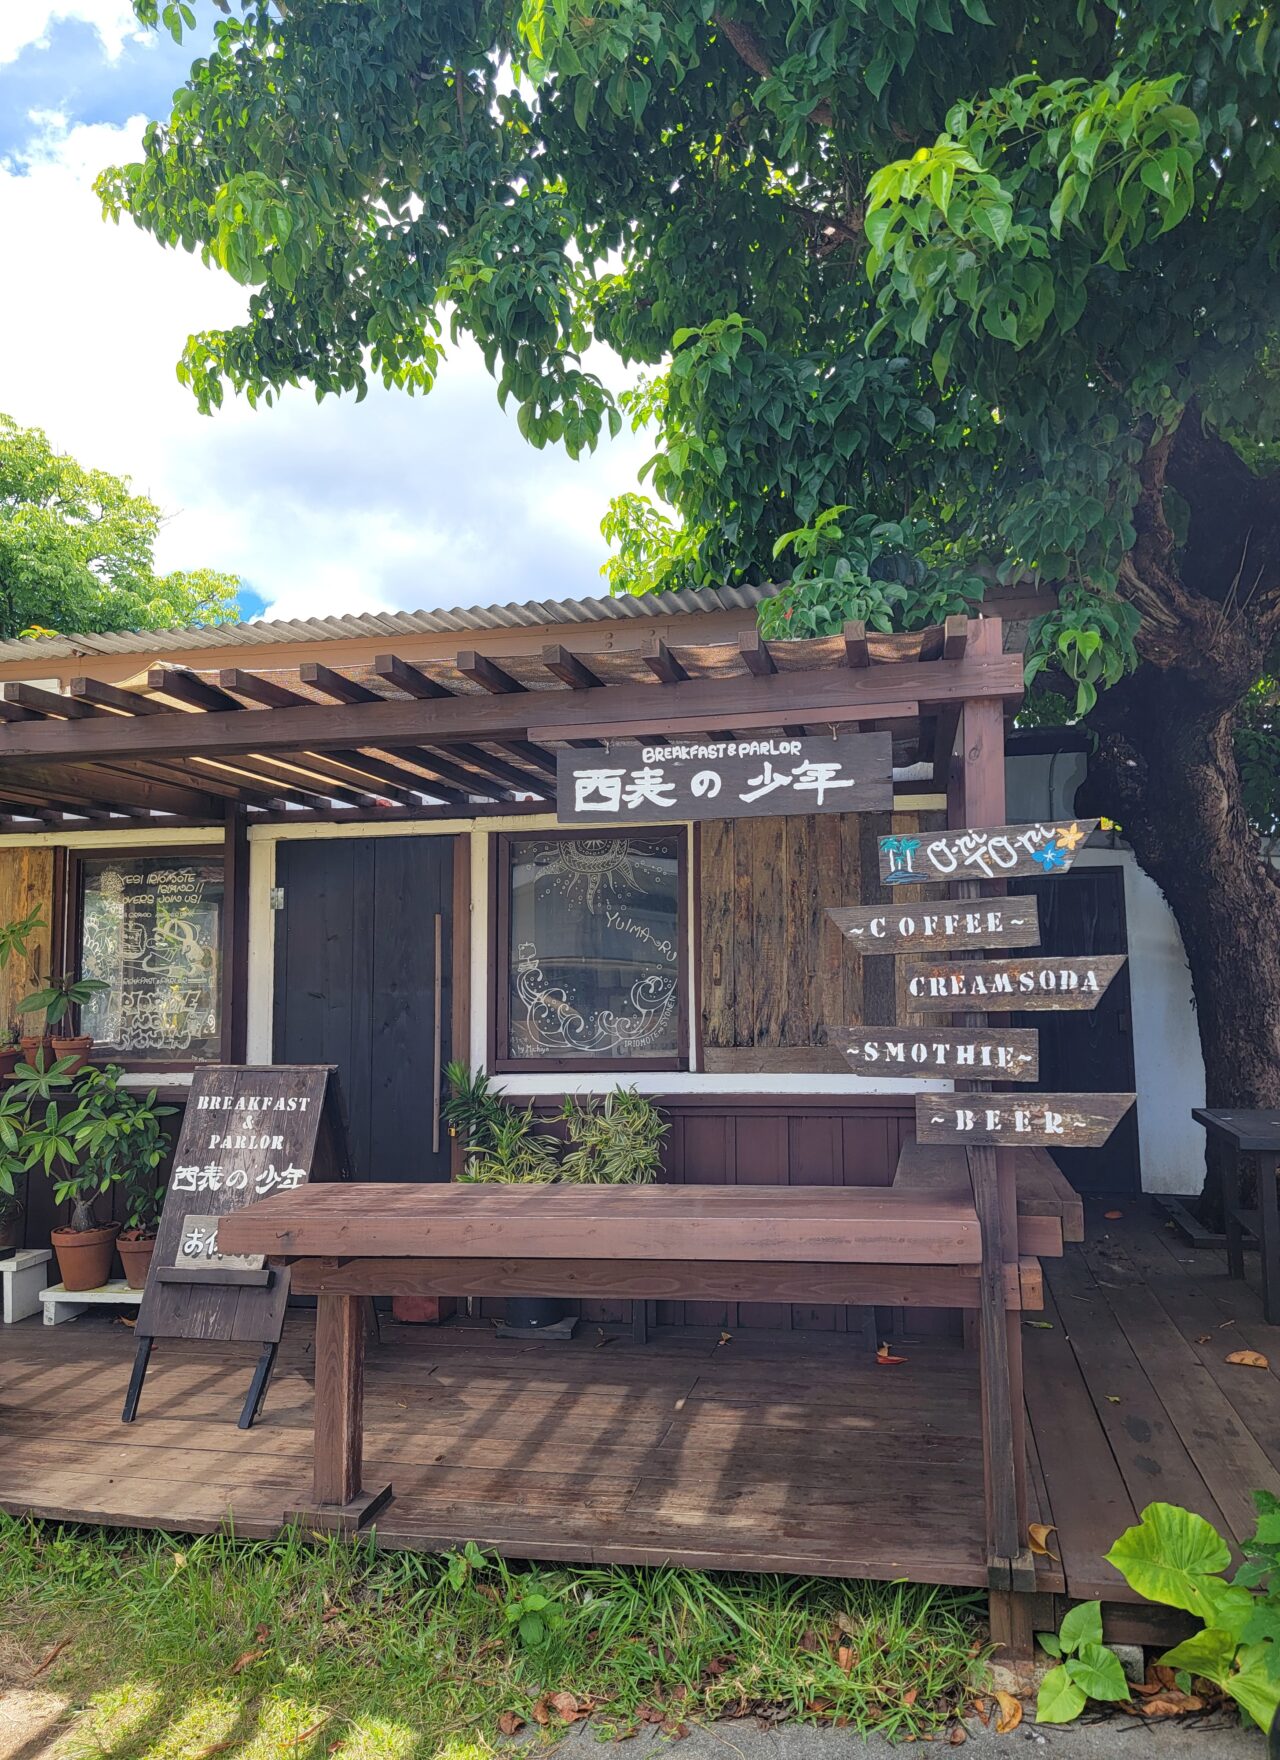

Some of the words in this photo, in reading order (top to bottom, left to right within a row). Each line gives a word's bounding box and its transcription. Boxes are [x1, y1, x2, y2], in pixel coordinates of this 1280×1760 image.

[197, 1096, 310, 1111] BREAKFAST
[242, 1115, 254, 1130] &
[208, 1135, 284, 1150] PARLOR
